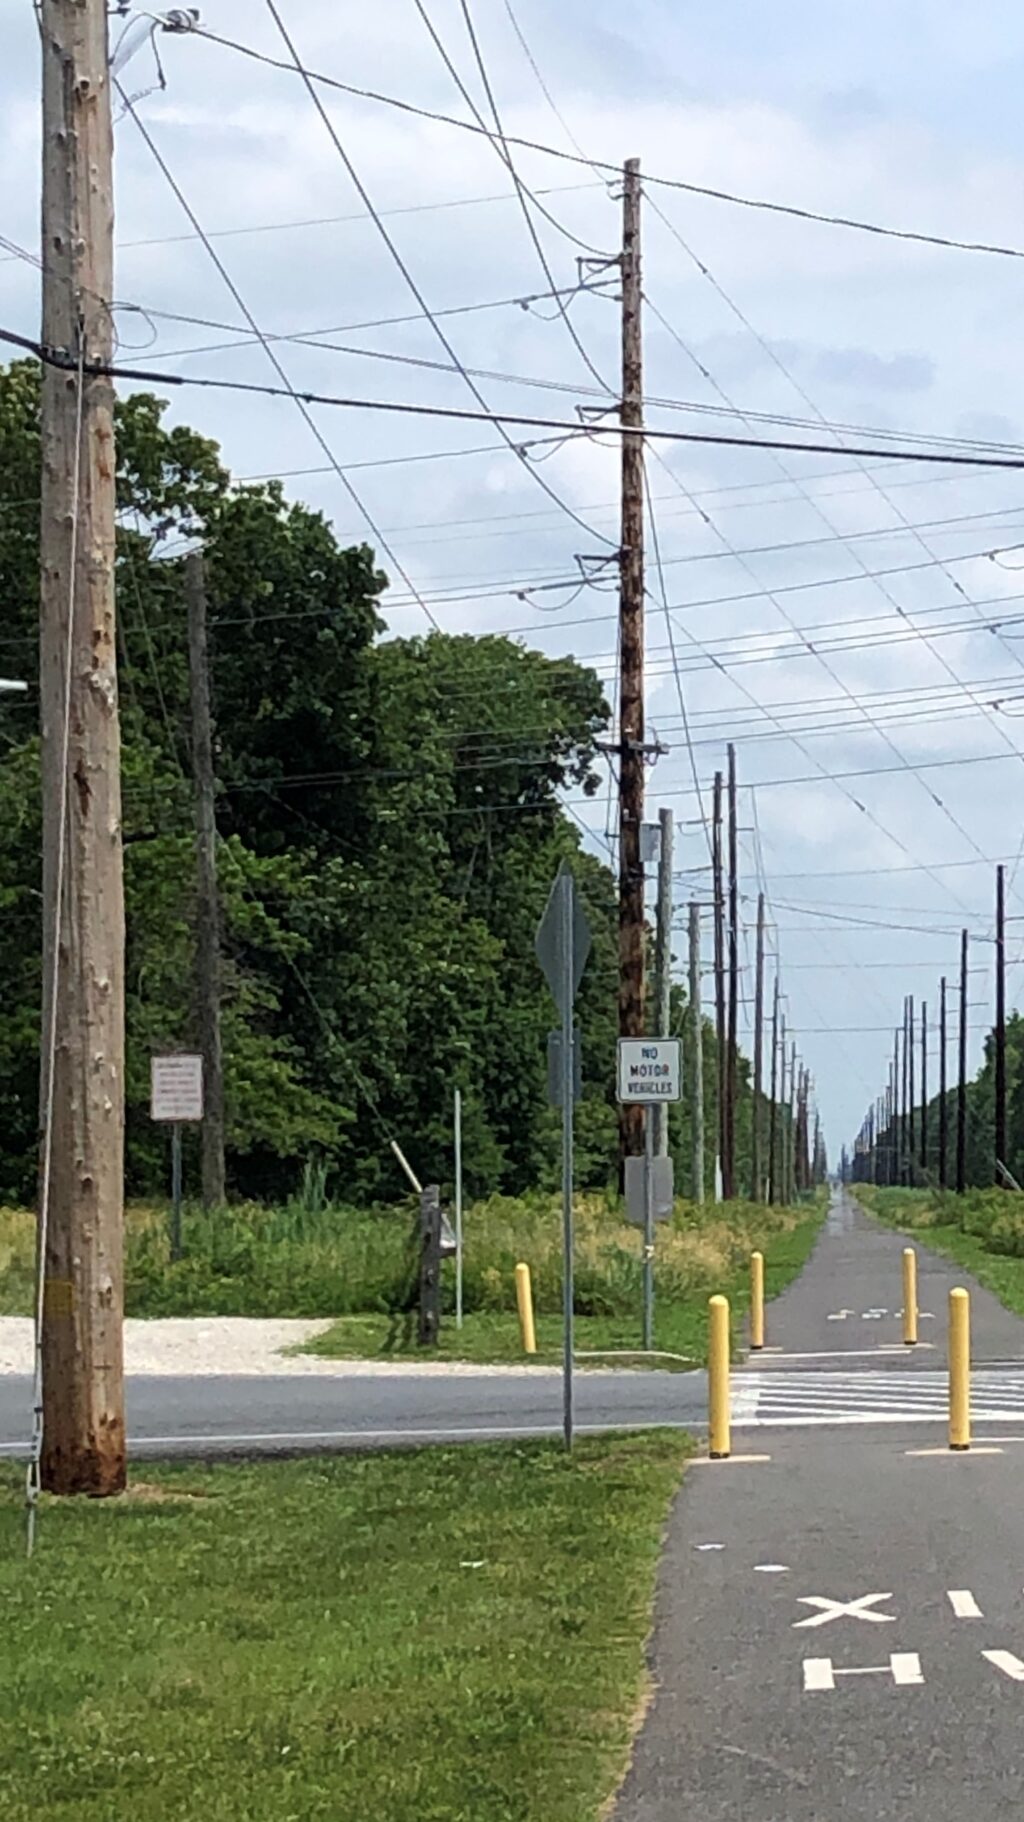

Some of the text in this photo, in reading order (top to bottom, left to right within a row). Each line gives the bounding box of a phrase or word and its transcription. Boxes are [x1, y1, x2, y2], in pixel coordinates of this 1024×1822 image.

[641, 1047, 658, 1059] NO
[630, 1064, 669, 1077] MOTOR
[627, 1082, 672, 1094] VEHICLES
